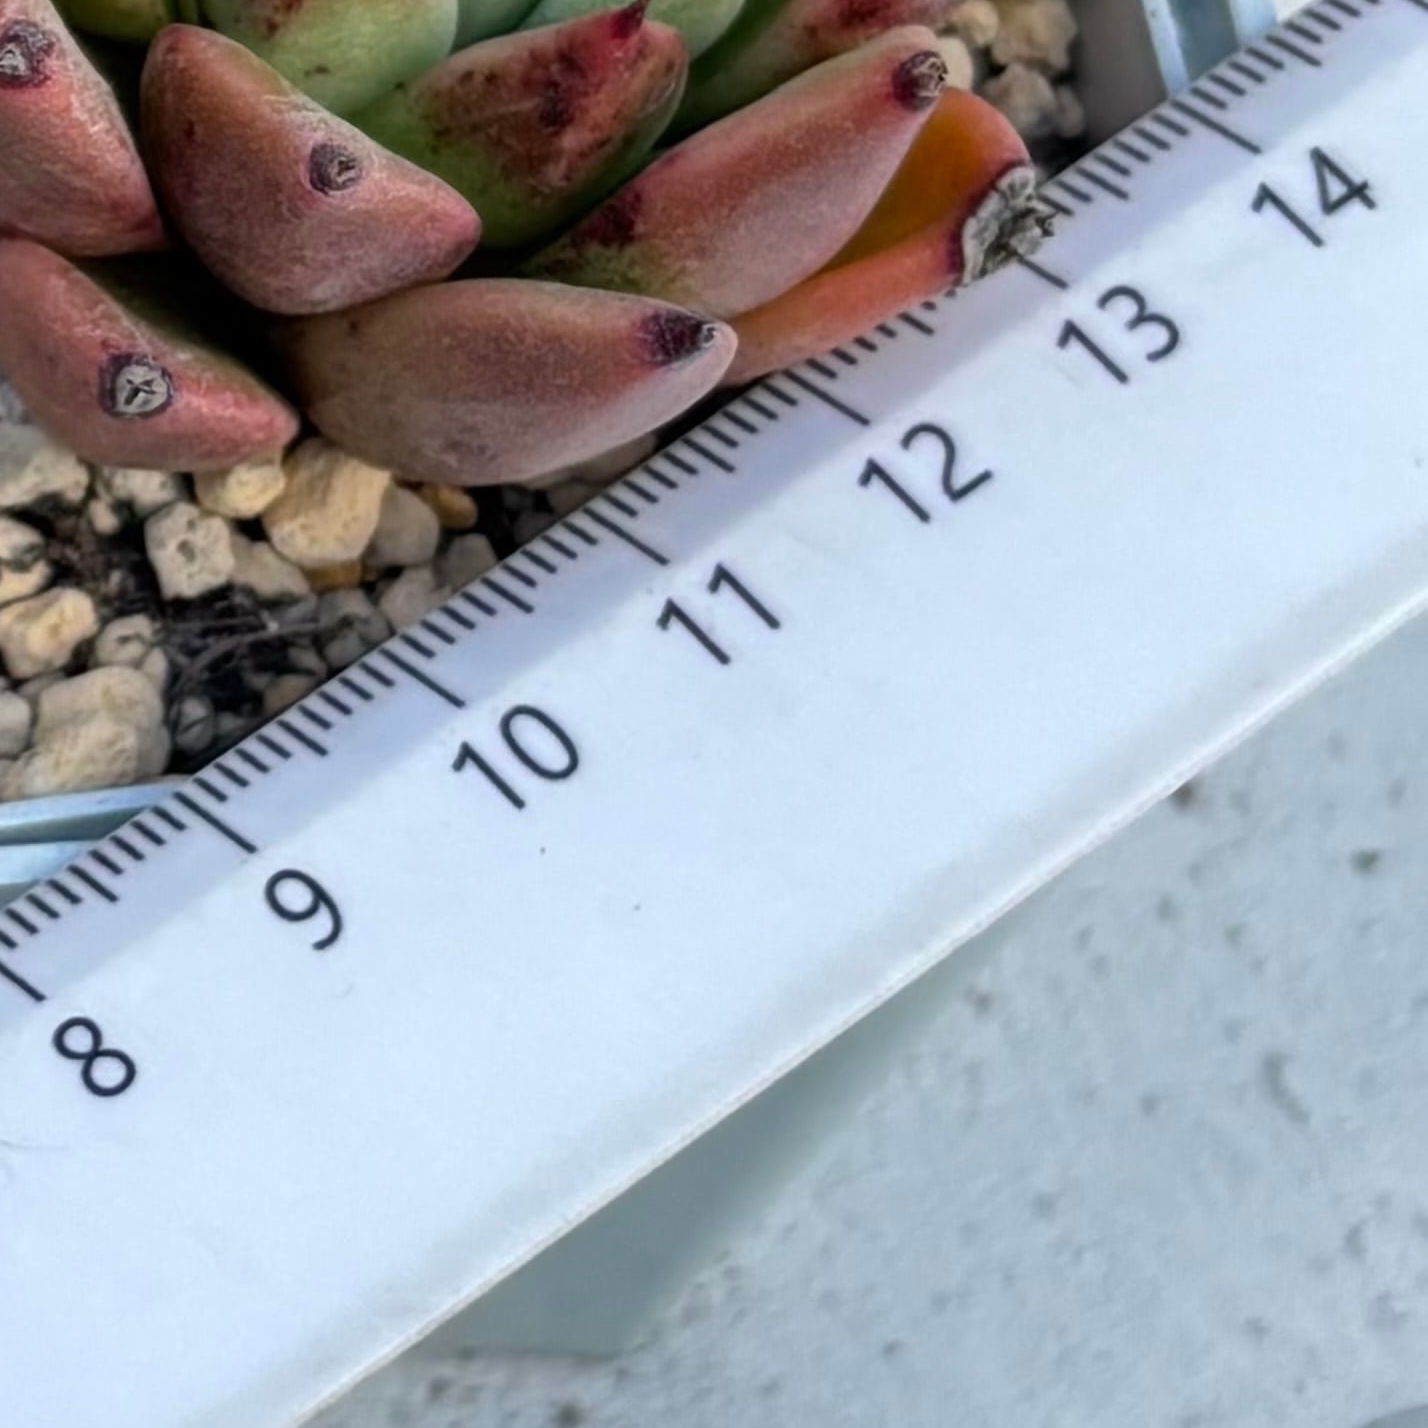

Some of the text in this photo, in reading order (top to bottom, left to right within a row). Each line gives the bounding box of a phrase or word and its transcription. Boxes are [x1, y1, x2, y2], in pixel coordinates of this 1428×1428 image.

[52, 1016, 138, 1098] 8
[264, 868, 343, 951] 9
[451, 704, 580, 810] 10
[657, 563, 781, 666] 11
[858, 422, 992, 523] 12
[1057, 283, 1180, 384] 13
[1252, 146, 1376, 247] 14
